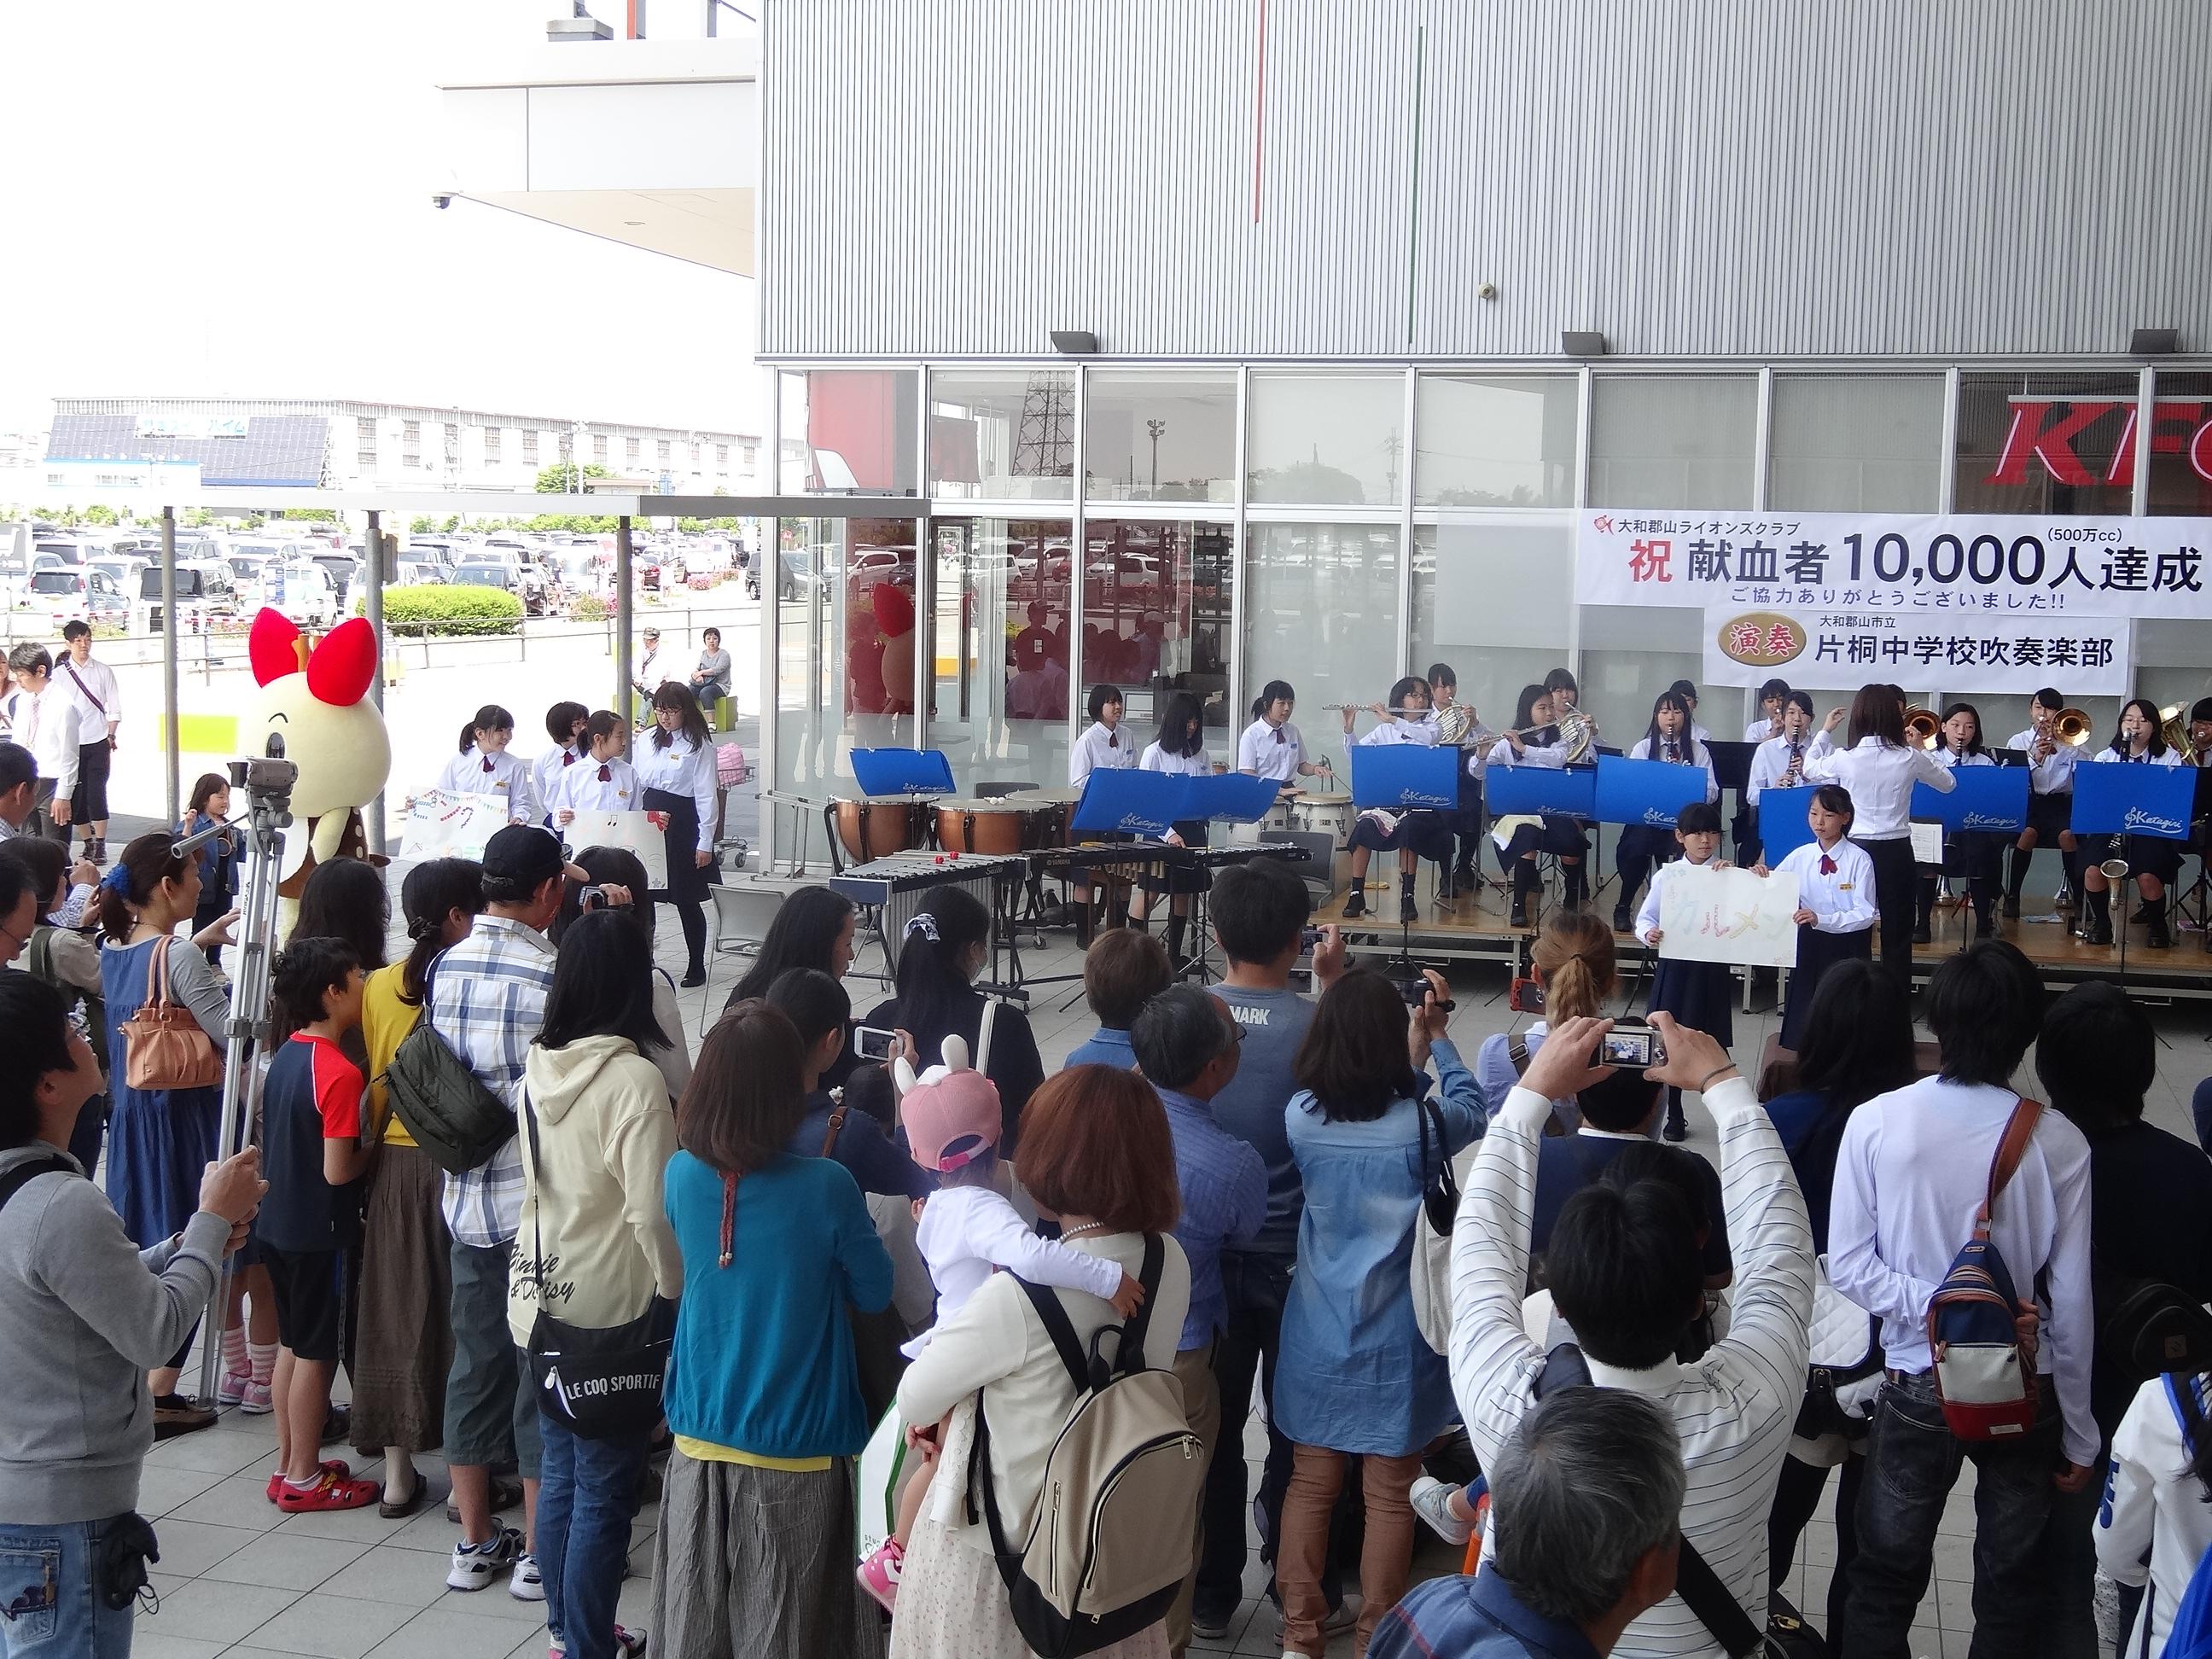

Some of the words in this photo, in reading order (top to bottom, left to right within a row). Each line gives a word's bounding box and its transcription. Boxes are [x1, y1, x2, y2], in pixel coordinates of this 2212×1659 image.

[1982, 402, 2212, 485] KF
[1617, 518, 1802, 536] 大和郡山ライオンズクラブ
[2047, 527, 2123, 543] (500万cc)
[1628, 538, 1673, 583] 祝
[1731, 587, 2065, 609] ご協力ありがとうございました!!
[1819, 615, 1896, 628] 大和郡山市立
[1729, 625, 1797, 655] 演奏
[1814, 633, 2114, 668] 片桐中学校吹奏楽部
[2136, 811, 2183, 830] Katagiri
[566, 1382, 583, 1400] LE
[584, 1377, 608, 1395] COQ
[611, 1373, 661, 1392] SPORTIF
